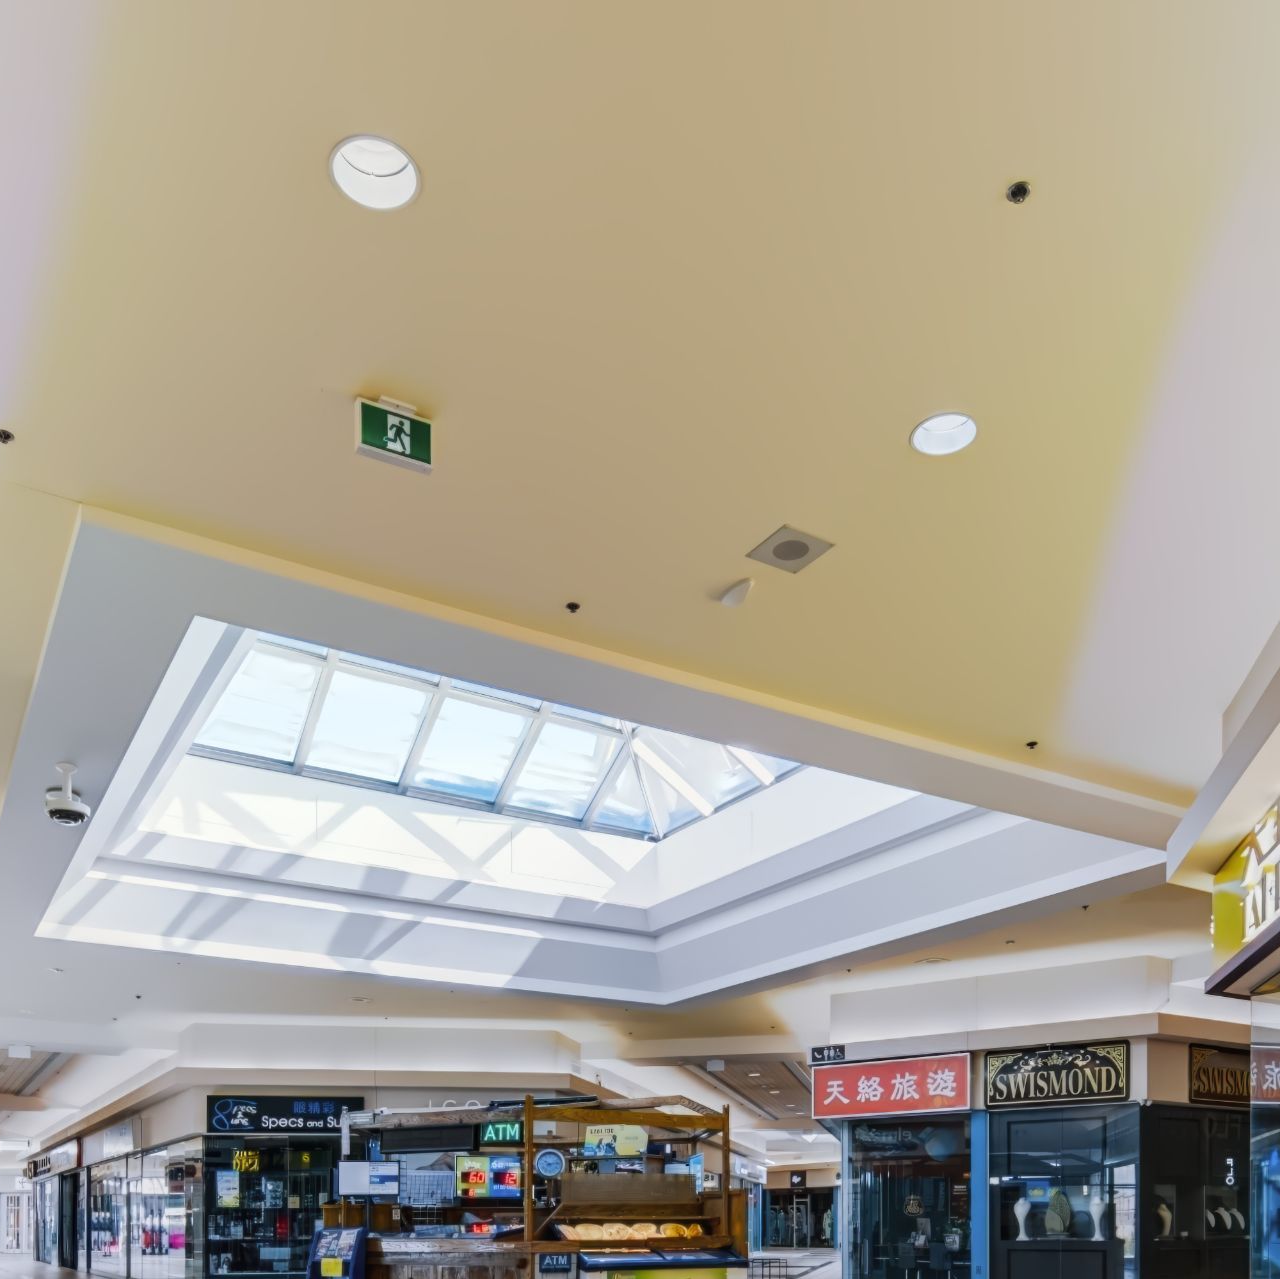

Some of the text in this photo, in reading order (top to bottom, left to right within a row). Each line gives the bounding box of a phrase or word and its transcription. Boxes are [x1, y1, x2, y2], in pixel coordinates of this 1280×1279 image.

[823, 1068, 958, 1105] 天絡旅遊
[995, 1066, 1117, 1100] SWISMOND
[261, 1115, 342, 1129] Specs and Su
[484, 1124, 519, 1141] ATM
[468, 1172, 485, 1184] 60
[543, 1255, 567, 1265] ATM
